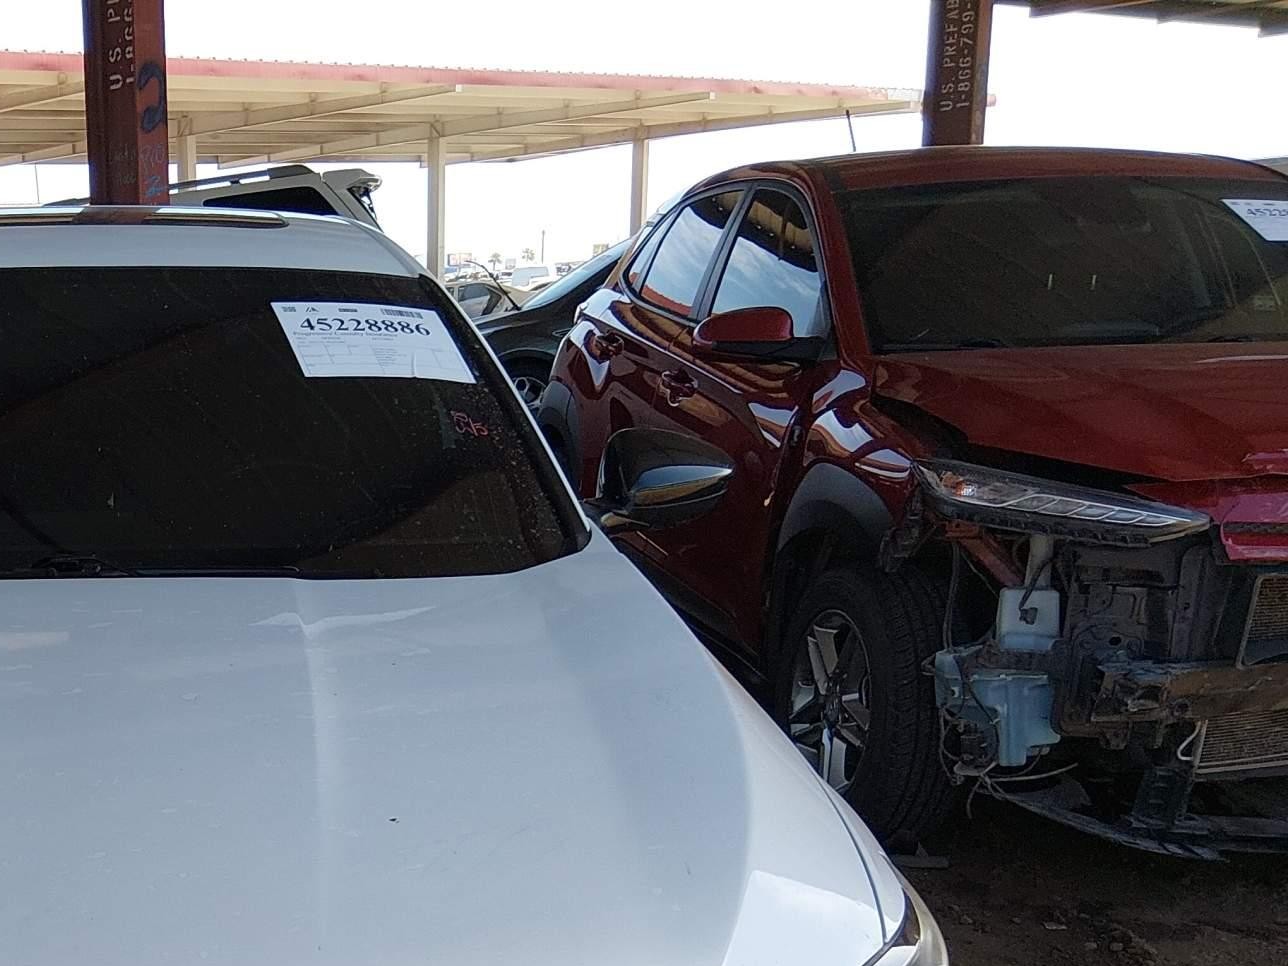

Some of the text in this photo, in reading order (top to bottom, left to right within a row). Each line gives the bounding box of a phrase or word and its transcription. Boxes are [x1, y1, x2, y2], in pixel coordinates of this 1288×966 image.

[955, 0, 975, 108] 1-866-799-
[939, 78, 955, 112] U.S.
[300, 317, 431, 336] 45228886
